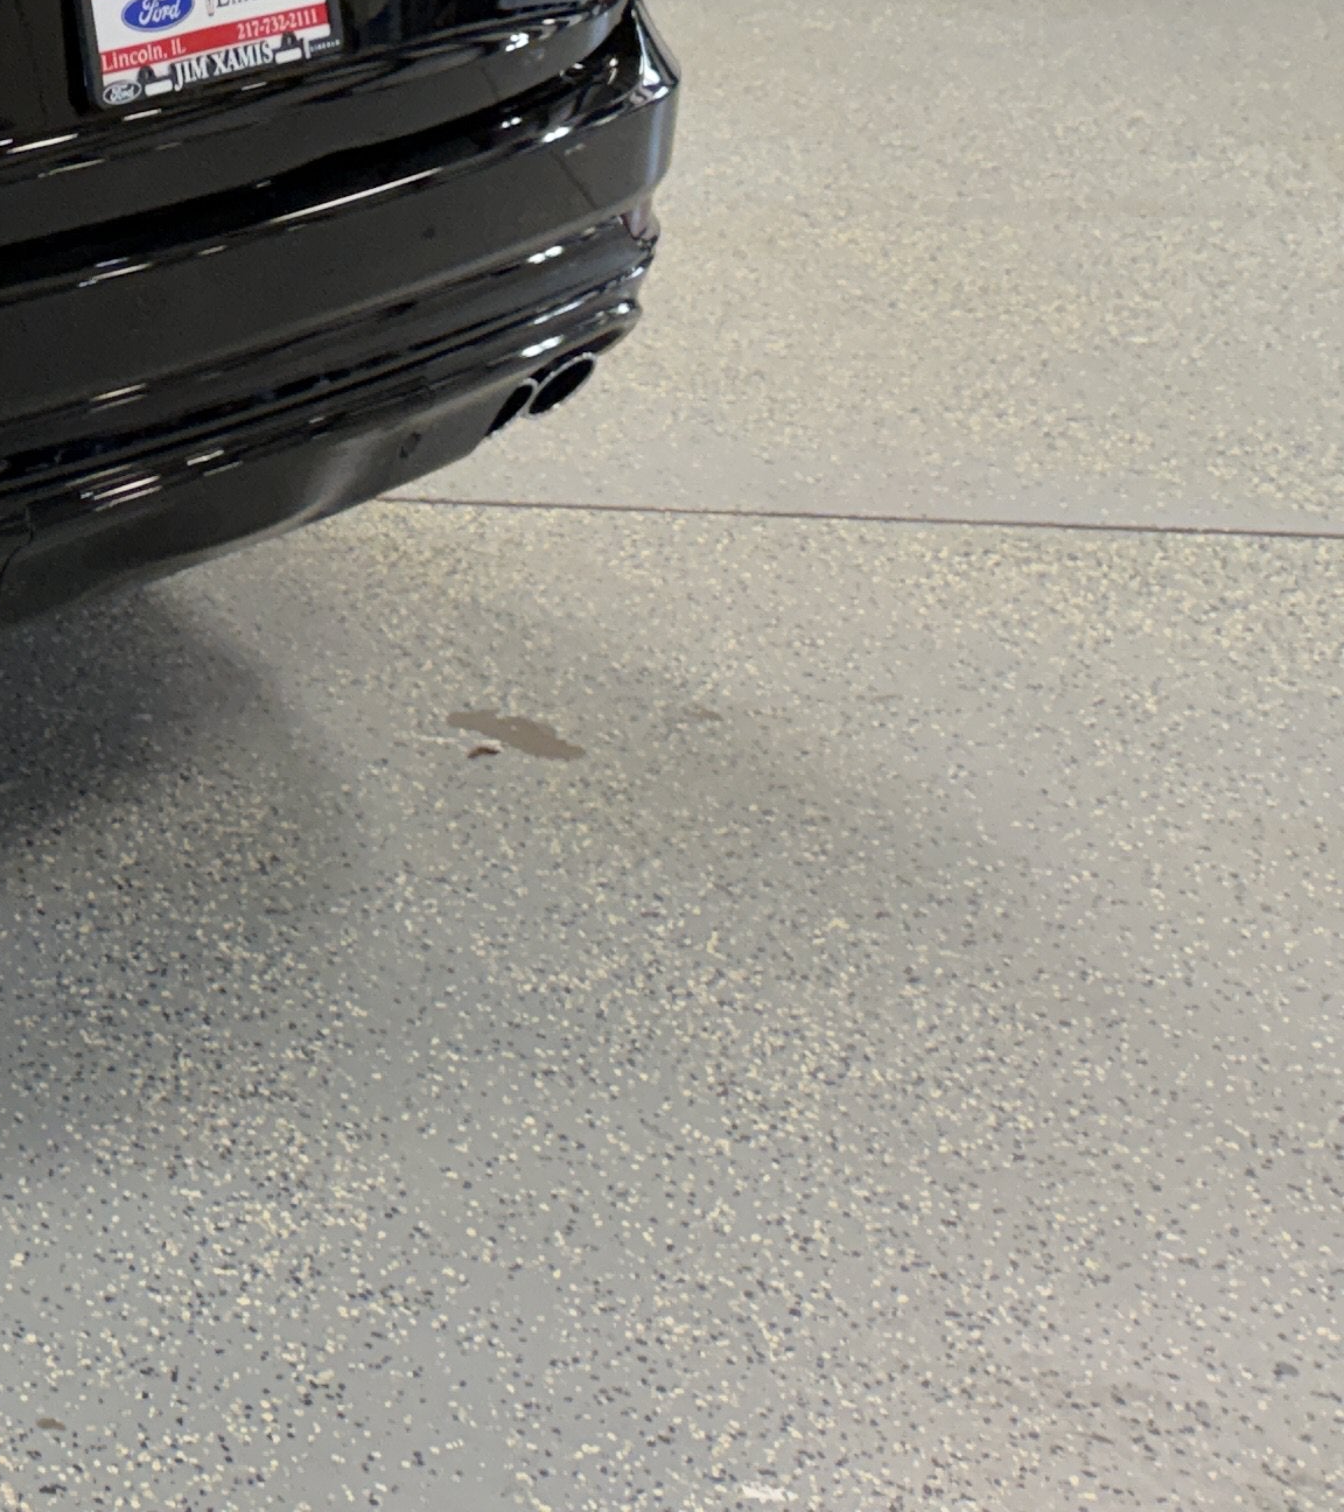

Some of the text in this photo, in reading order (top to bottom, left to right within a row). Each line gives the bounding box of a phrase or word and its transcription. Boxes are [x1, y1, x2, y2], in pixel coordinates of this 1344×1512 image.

[236, 7, 318, 41] 217-732-2111
[170, 37, 188, 58] IL
[174, 60, 208, 91] JIM
[212, 40, 274, 75] XAMIS
